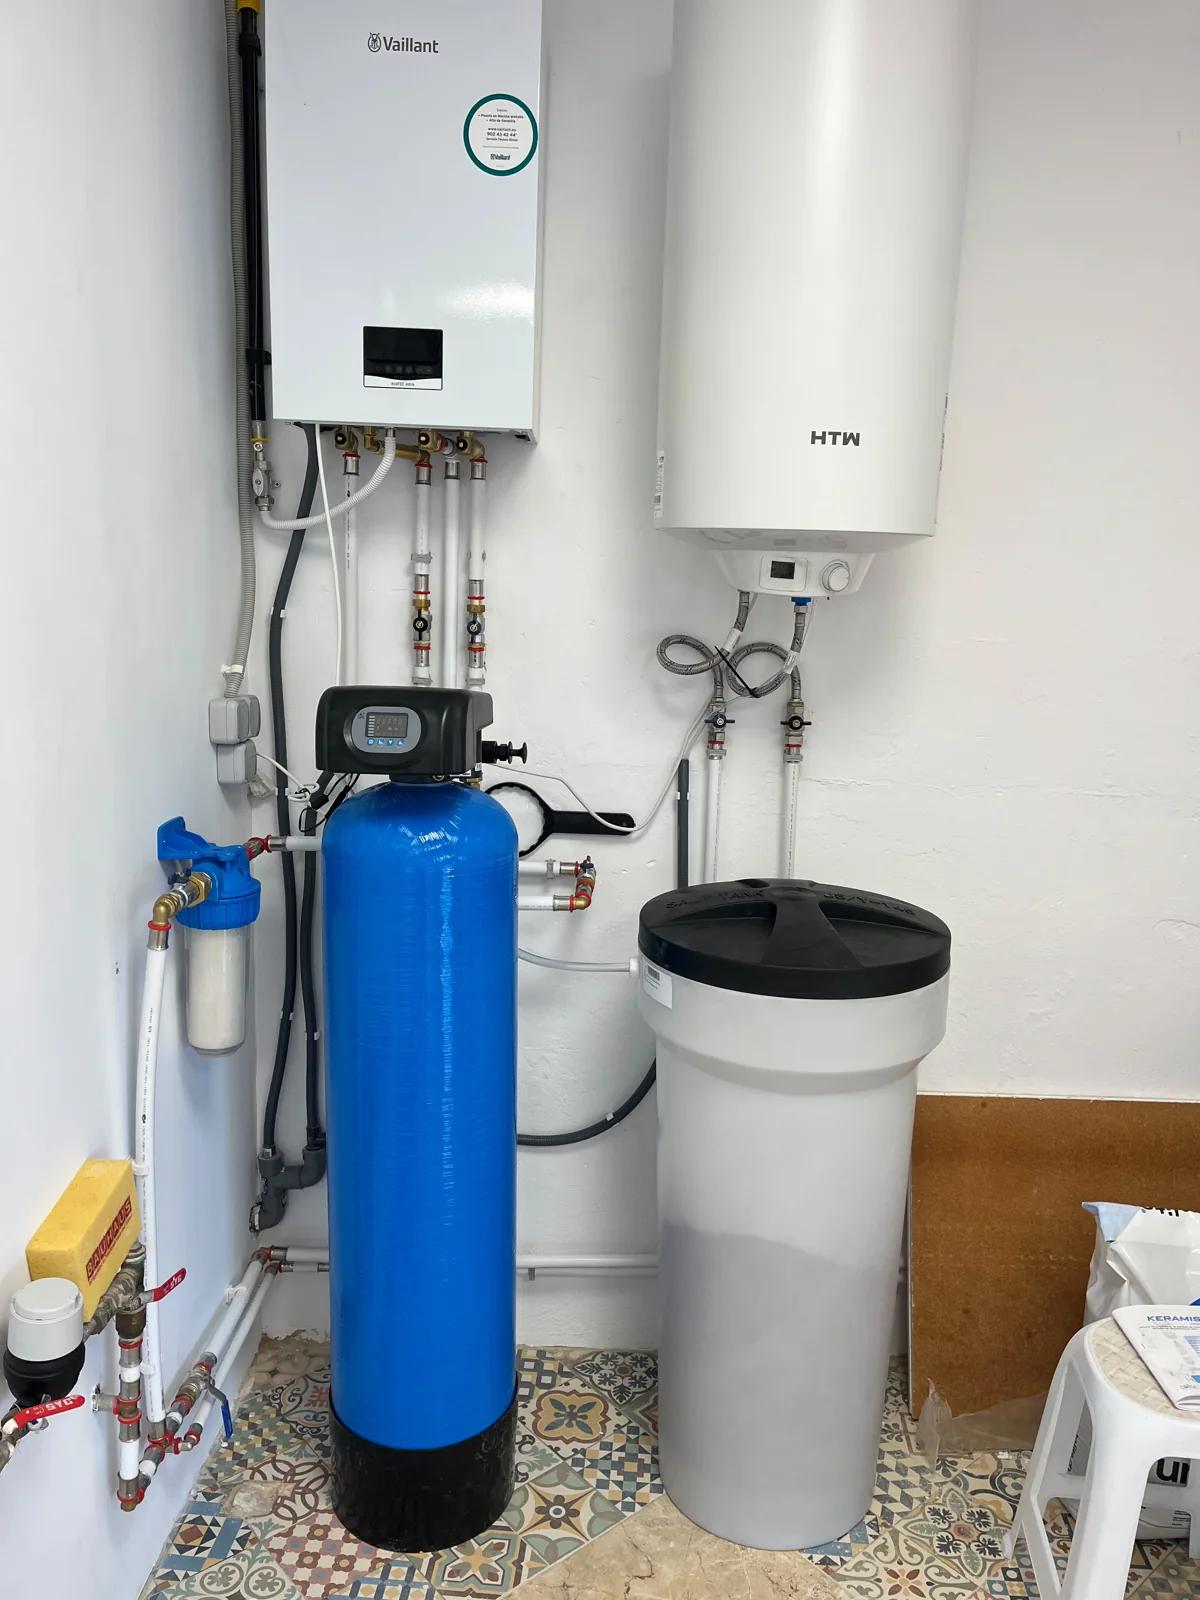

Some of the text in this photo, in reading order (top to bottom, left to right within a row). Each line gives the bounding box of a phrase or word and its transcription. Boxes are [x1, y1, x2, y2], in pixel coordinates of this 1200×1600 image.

[383, 36, 439, 54] Vaillant
[811, 431, 861, 446] HTW
[86, 1198, 132, 1279] BAUHAUS
